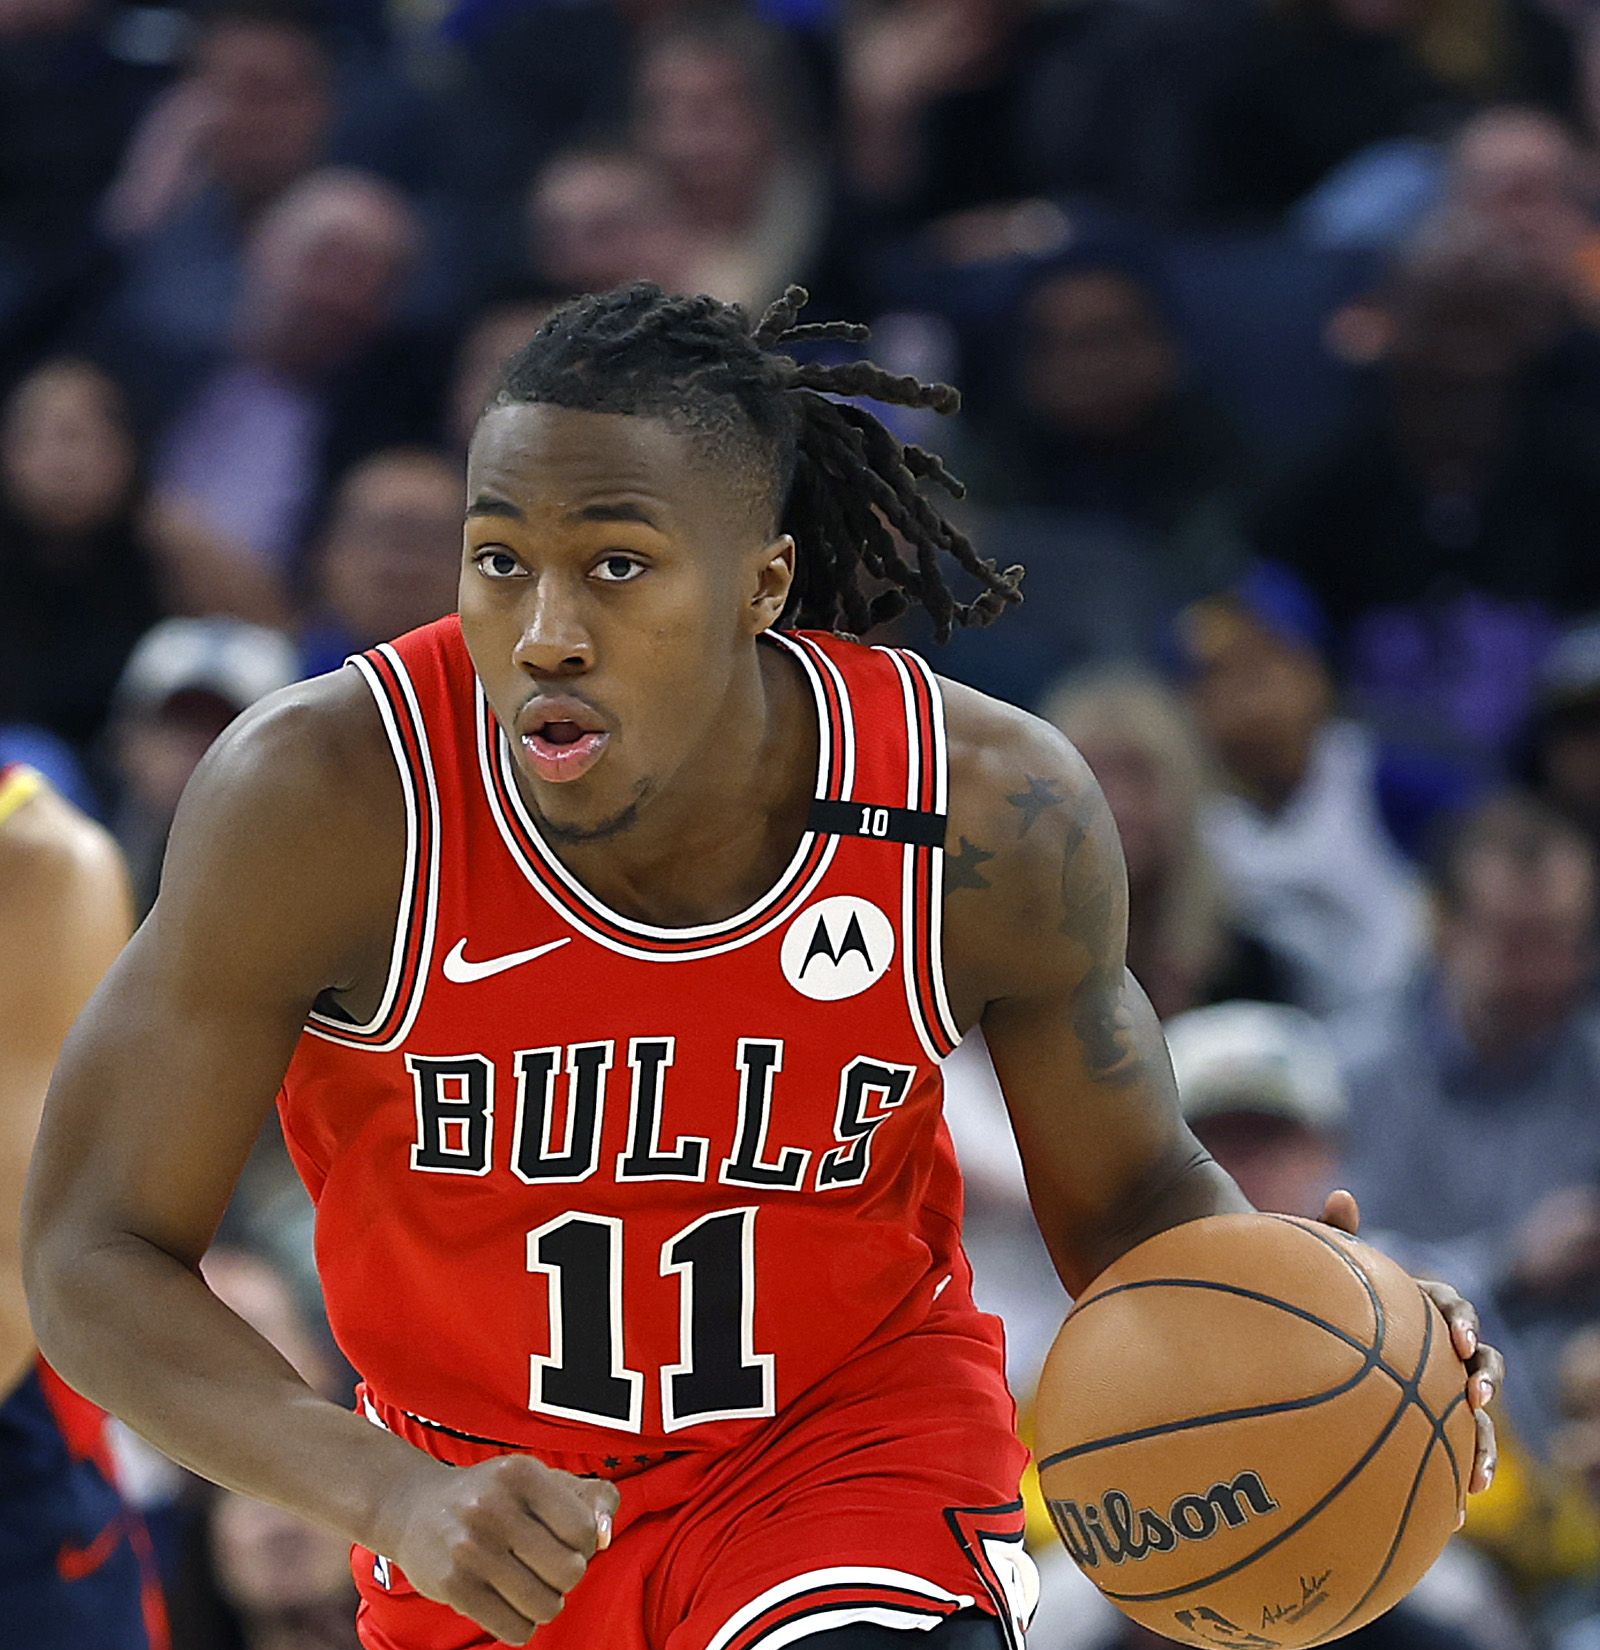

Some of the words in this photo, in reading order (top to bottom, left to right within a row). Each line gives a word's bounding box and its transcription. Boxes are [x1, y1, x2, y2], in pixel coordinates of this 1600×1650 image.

[859, 807, 889, 836] 10
[404, 1037, 916, 1192] BULLS
[526, 1205, 776, 1434] 11
[1046, 1469, 1280, 1568] Wilson
